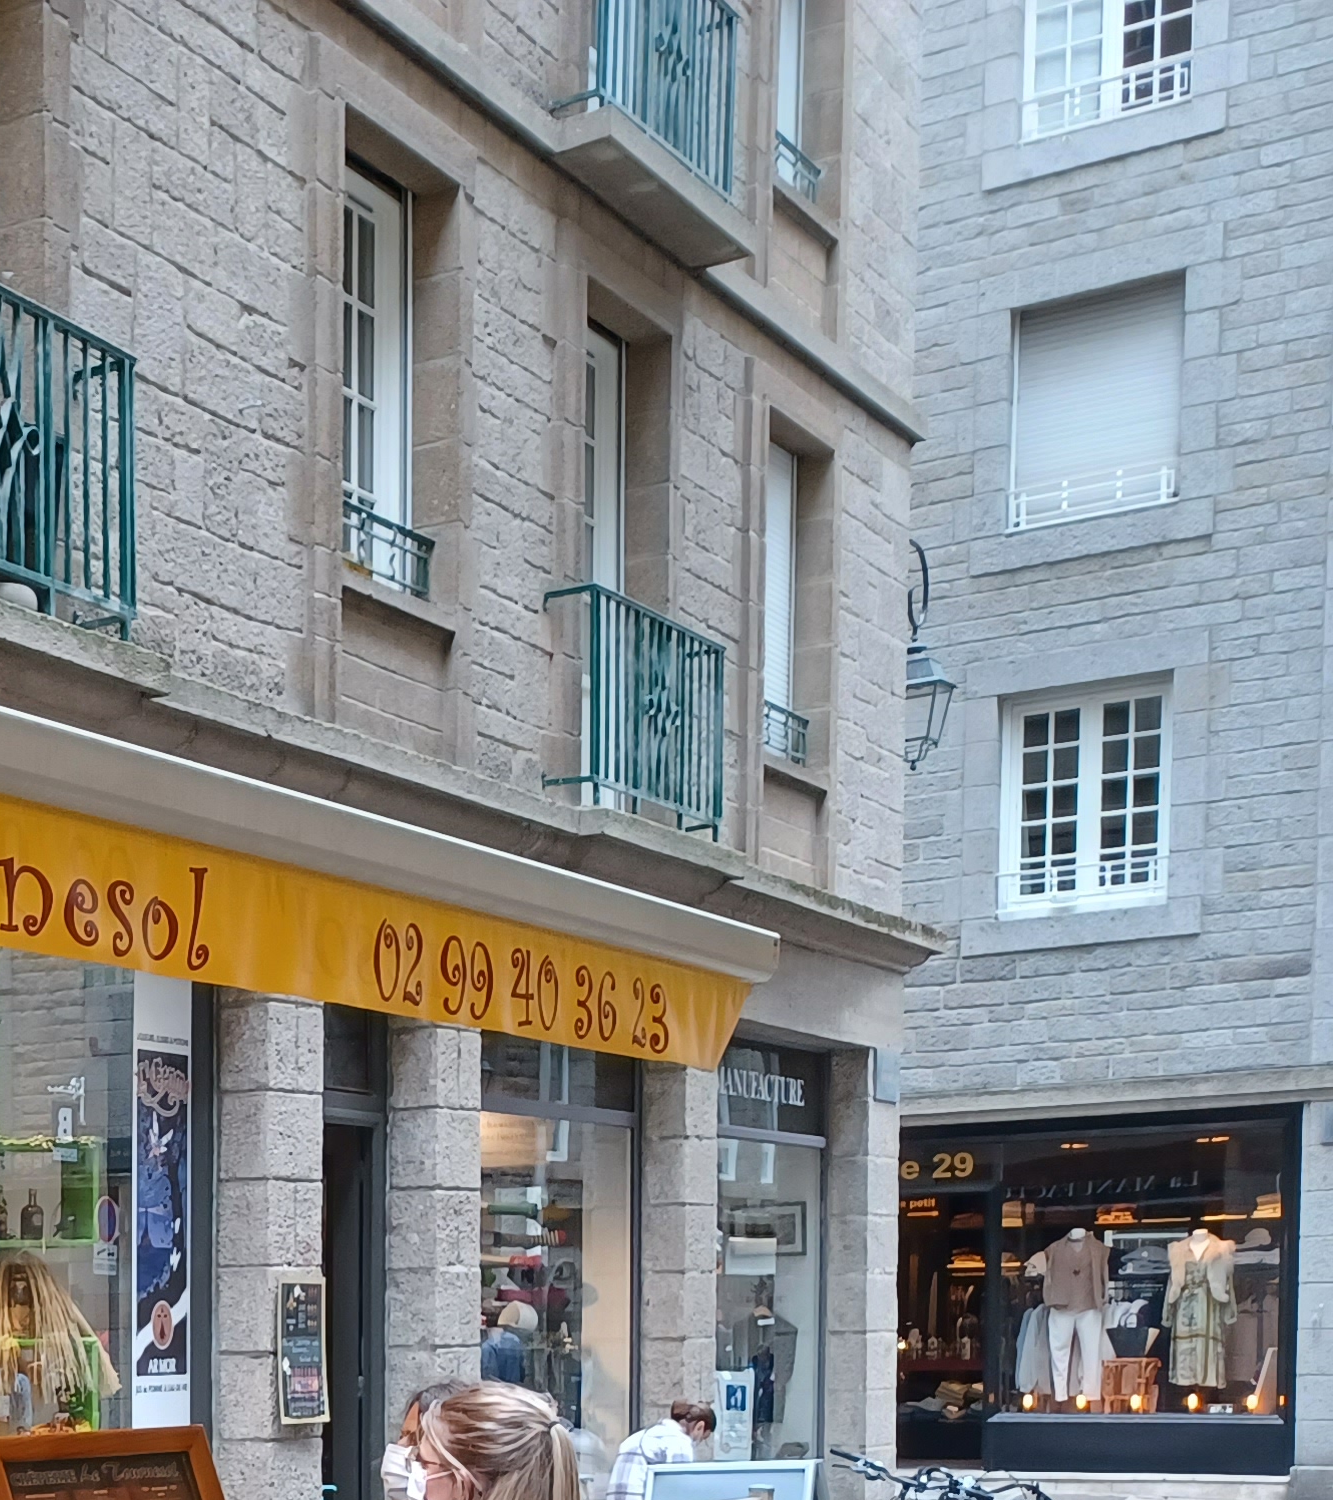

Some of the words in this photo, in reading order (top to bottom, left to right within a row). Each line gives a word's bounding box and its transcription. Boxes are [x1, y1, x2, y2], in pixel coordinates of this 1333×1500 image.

[372, 916, 424, 1007] 02
[439, 934, 494, 1021] 99
[510, 947, 560, 1032] 40
[573, 964, 617, 1043] 36
[630, 977, 670, 1054] 23
[900, 1160, 920, 1180] e
[932, 1152, 974, 1179] 29
